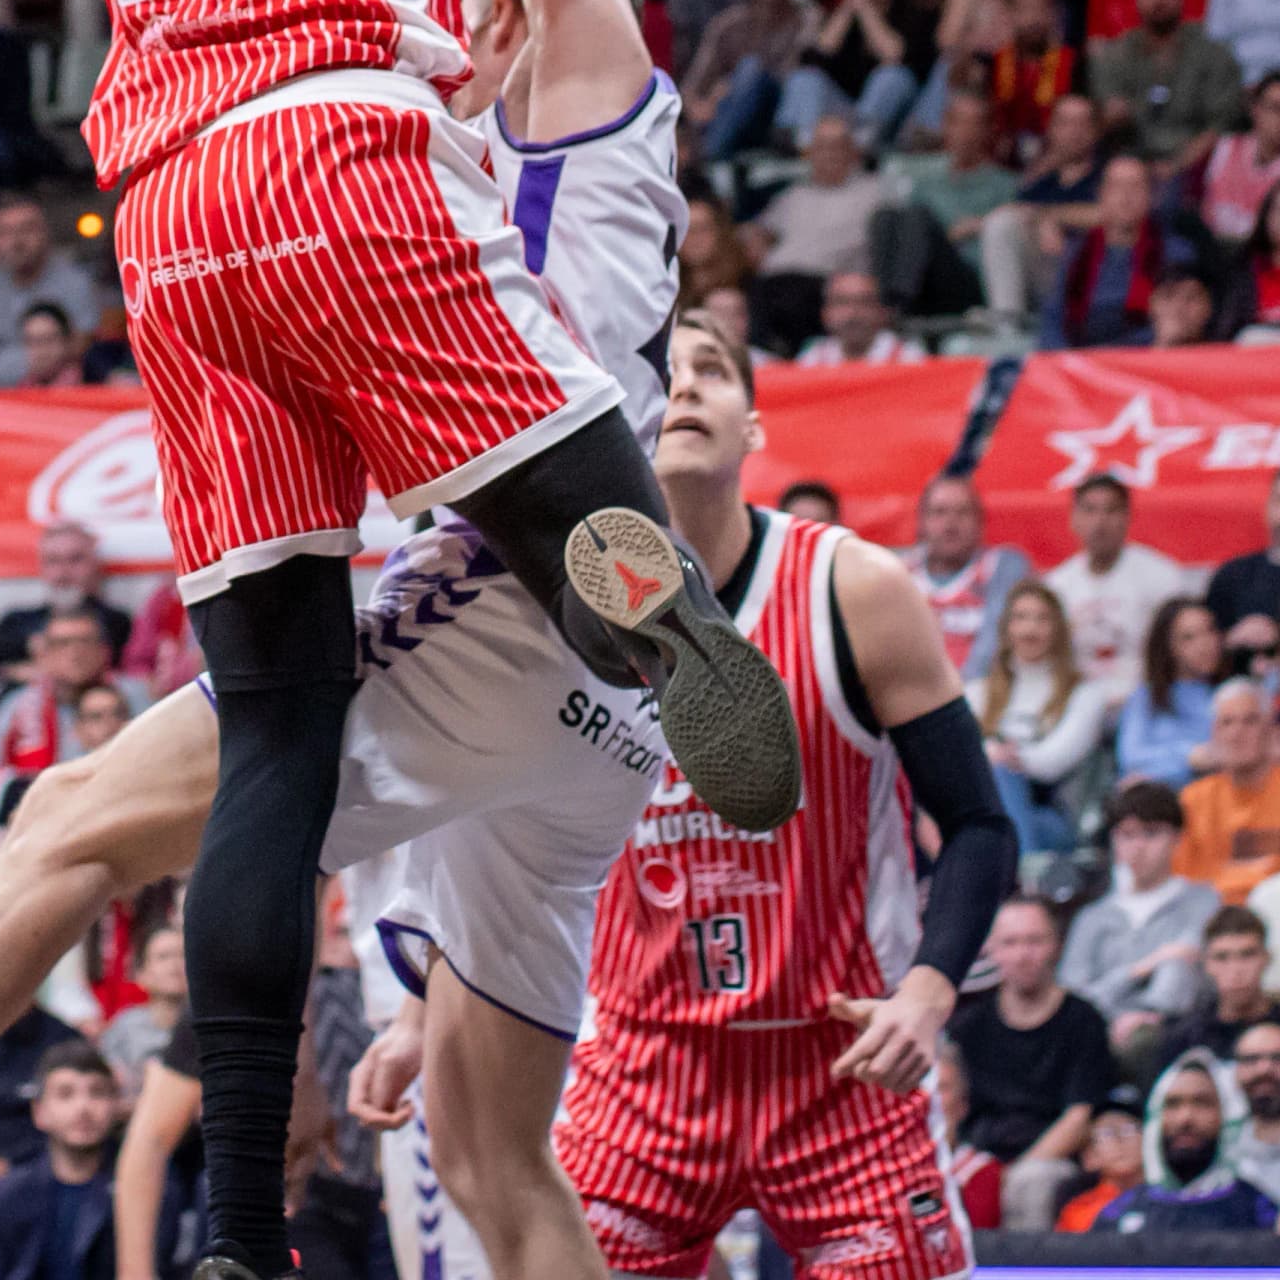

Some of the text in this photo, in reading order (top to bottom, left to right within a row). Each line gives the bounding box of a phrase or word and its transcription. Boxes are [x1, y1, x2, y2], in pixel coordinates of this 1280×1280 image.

[226, 250, 249, 269] DE
[251, 233, 329, 263] MURCIA
[684, 913, 750, 994] 13
